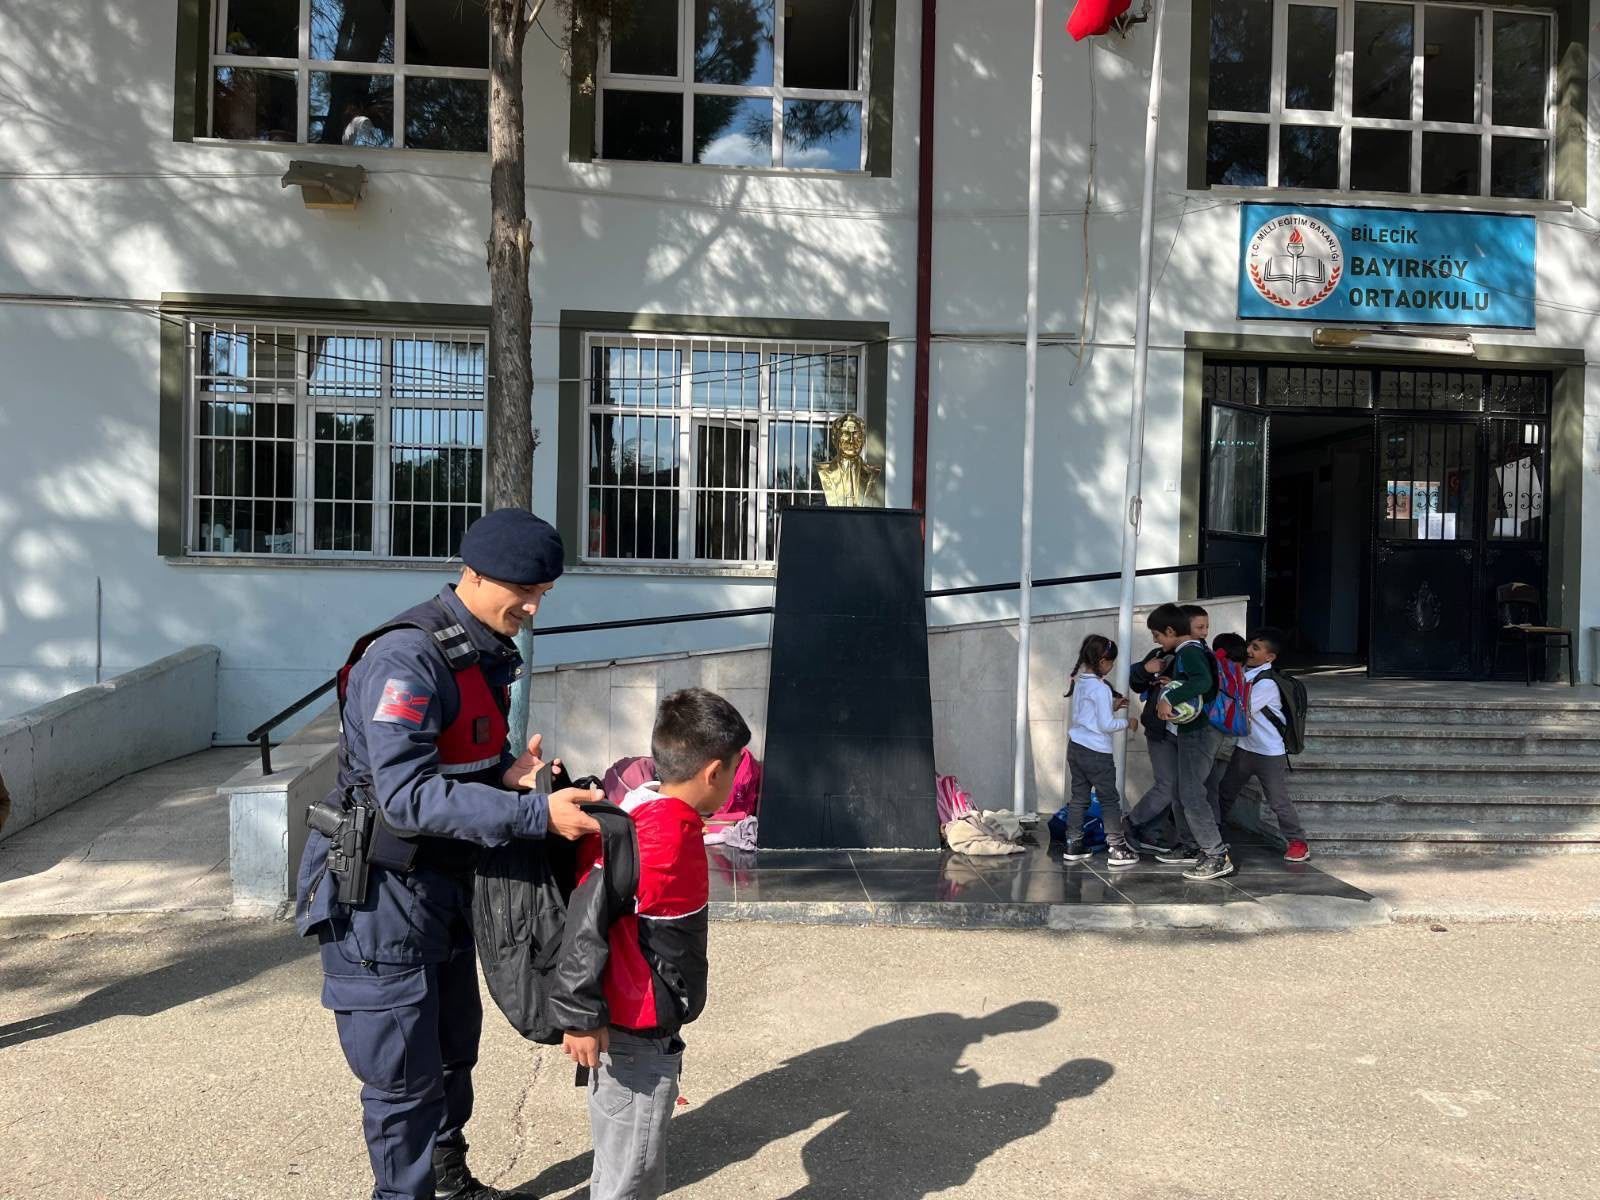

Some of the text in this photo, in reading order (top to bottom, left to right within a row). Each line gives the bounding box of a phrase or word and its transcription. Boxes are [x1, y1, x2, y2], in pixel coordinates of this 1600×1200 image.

[1309, 221, 1340, 262] BAKANLIĞI
[1351, 226, 1419, 244] BİLECİK
[1350, 256, 1468, 279] BAYIRKÖY
[1349, 287, 1490, 312] ORTAOKULU
